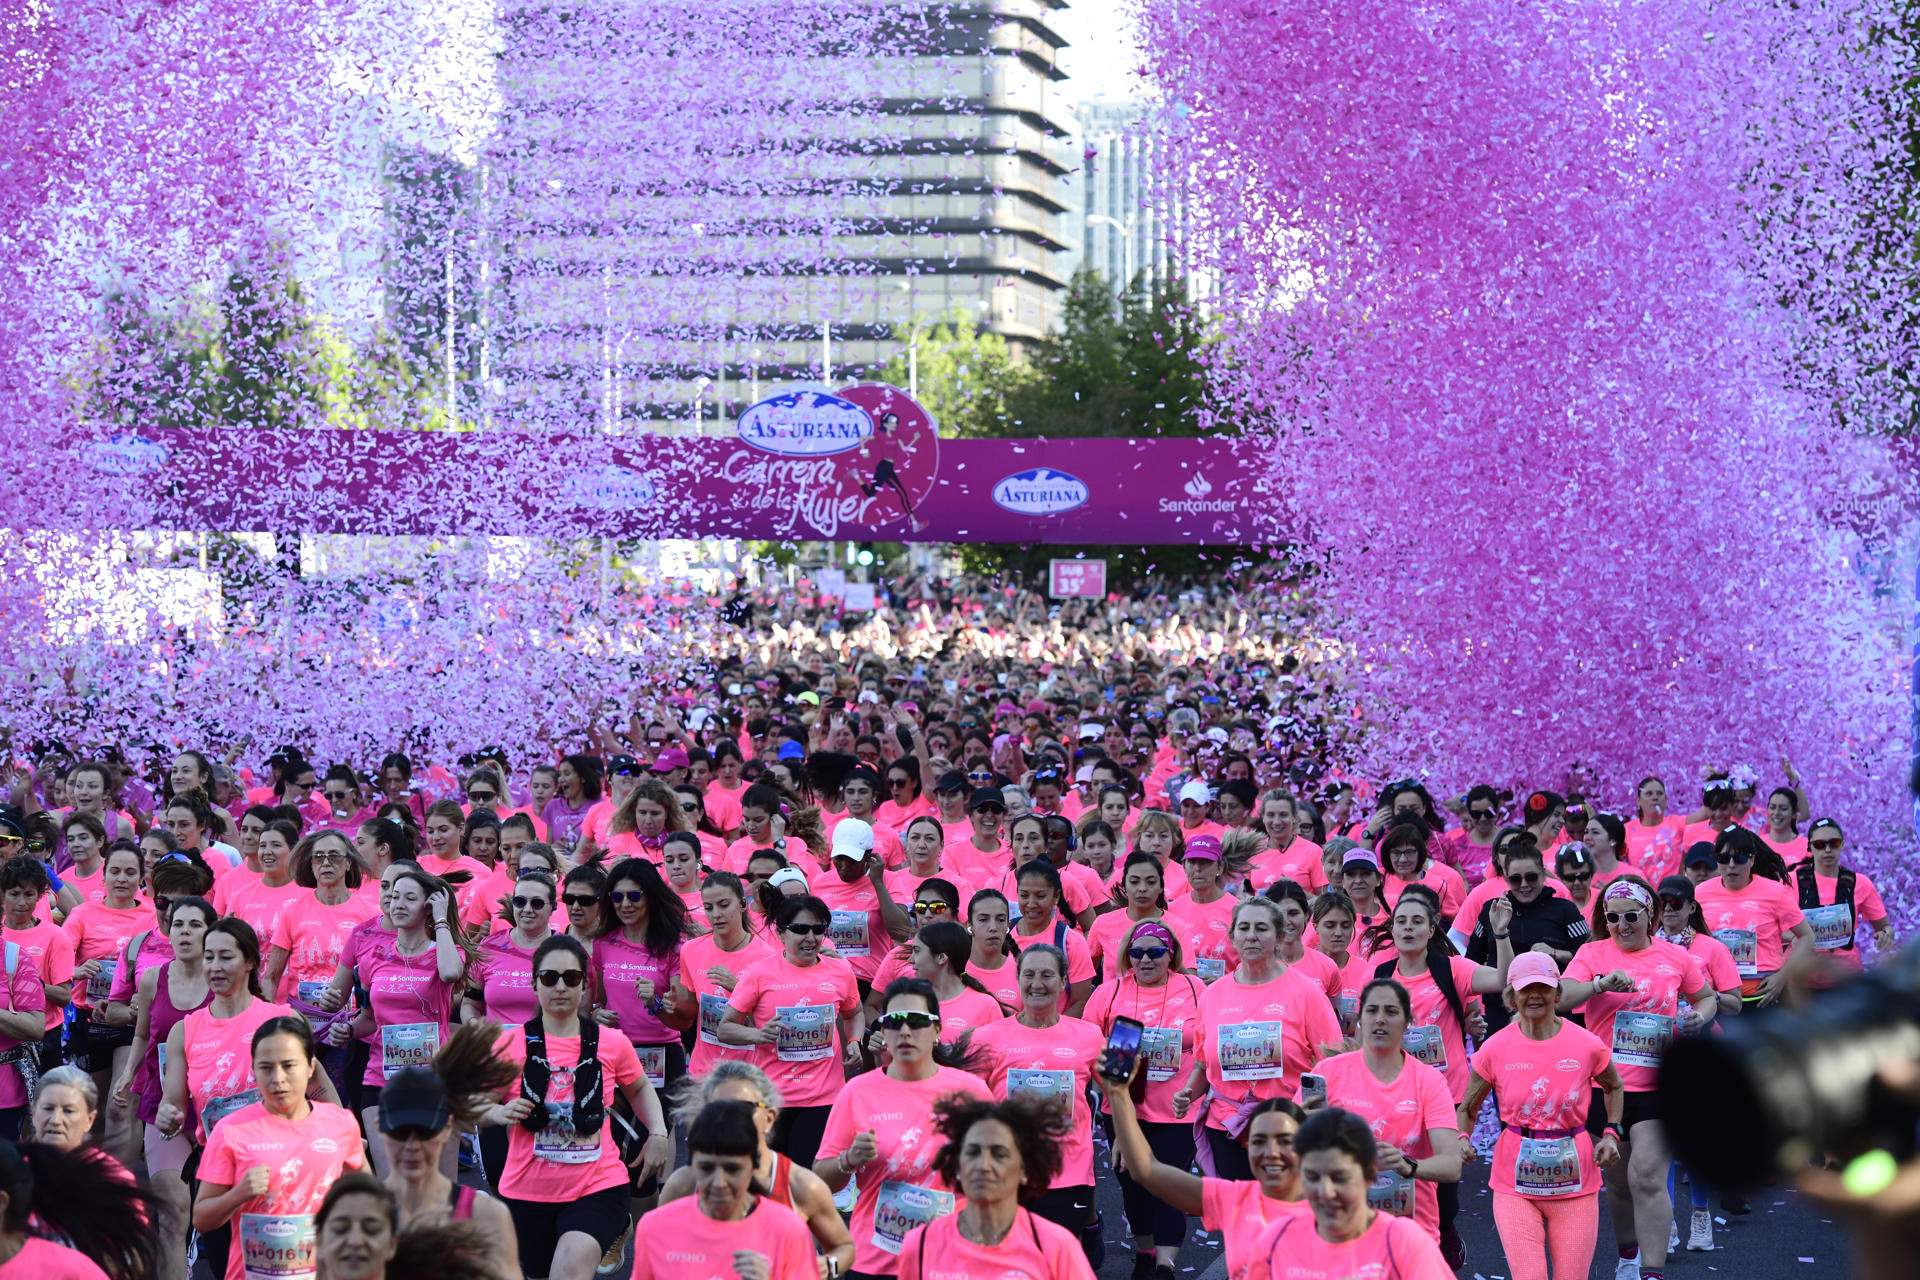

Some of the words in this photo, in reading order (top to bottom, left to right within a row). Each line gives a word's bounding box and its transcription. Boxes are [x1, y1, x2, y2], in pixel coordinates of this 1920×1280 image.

[724, 449, 836, 486] Carrera
[751, 484, 774, 509] de
[1000, 486, 1081, 502] ASTURIANA
[787, 481, 878, 537] Mujer
[1159, 498, 1237, 512] Santander
[797, 1030, 819, 1040] 016
[1633, 1035, 1656, 1046] 016
[399, 1047, 421, 1058] 016
[1238, 1047, 1262, 1058] 016
[1409, 1050, 1426, 1059] 16
[869, 1111, 904, 1122] OYSHO
[247, 1142, 284, 1150] OYSHO
[1537, 1166, 1562, 1176] 016
[266, 1248, 296, 1261] 016
